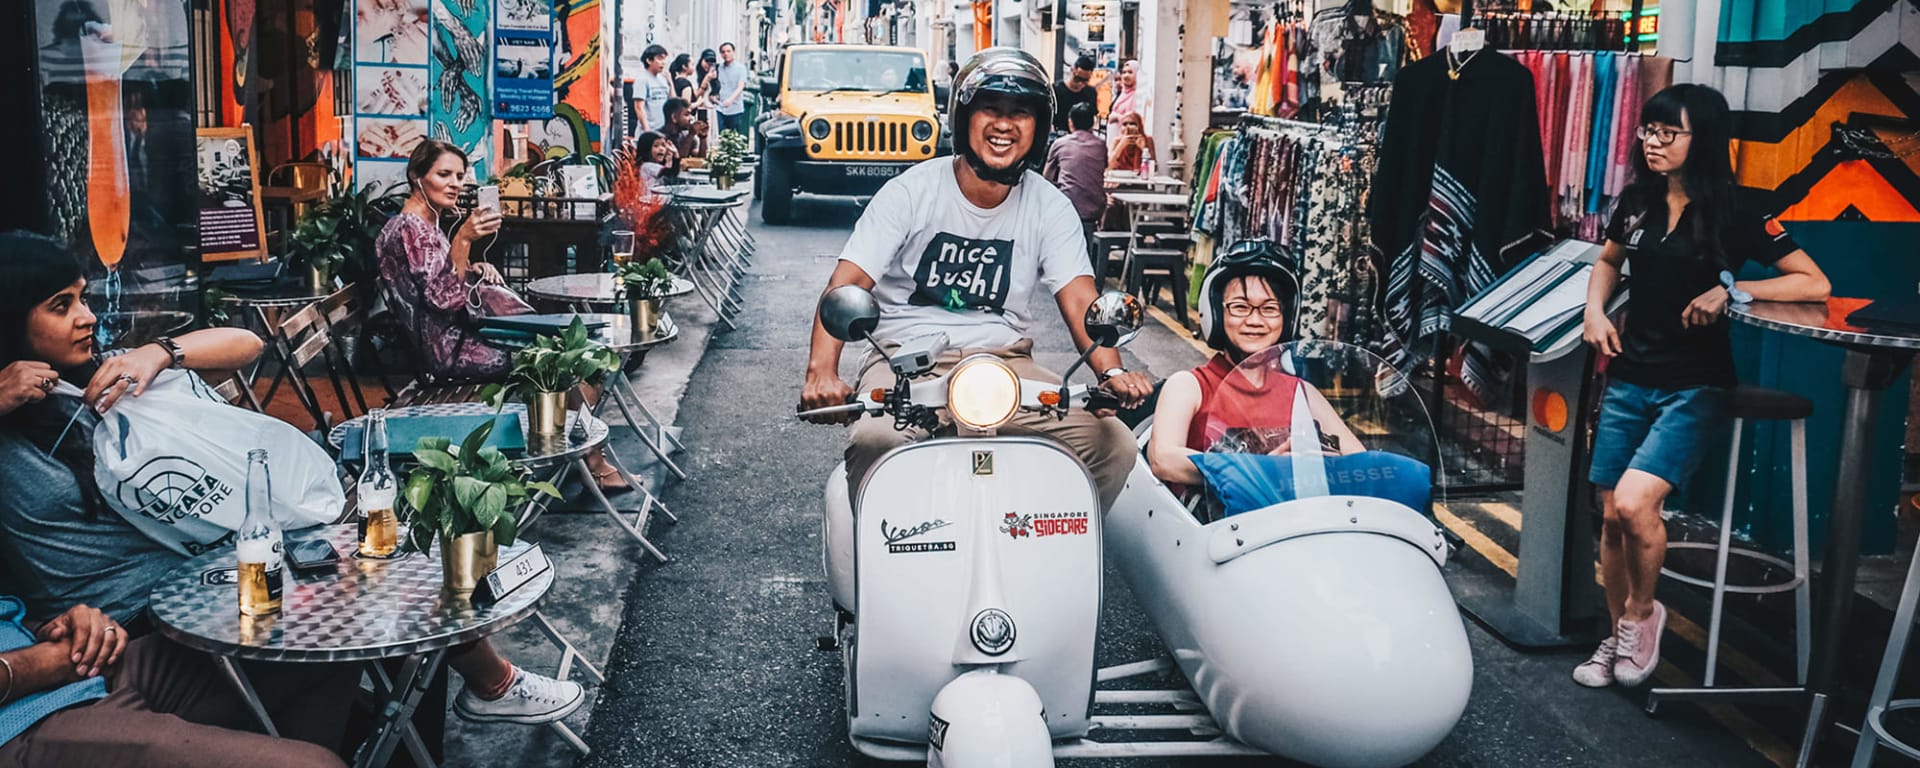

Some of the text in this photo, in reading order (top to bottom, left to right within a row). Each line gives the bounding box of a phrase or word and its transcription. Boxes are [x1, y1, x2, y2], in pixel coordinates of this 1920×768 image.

[939, 240, 998, 264] nice
[926, 261, 1004, 300] bush!
[1034, 511, 1088, 519] SINGAPORE
[881, 517, 954, 547] Vespa
[515, 559, 533, 577] 431
